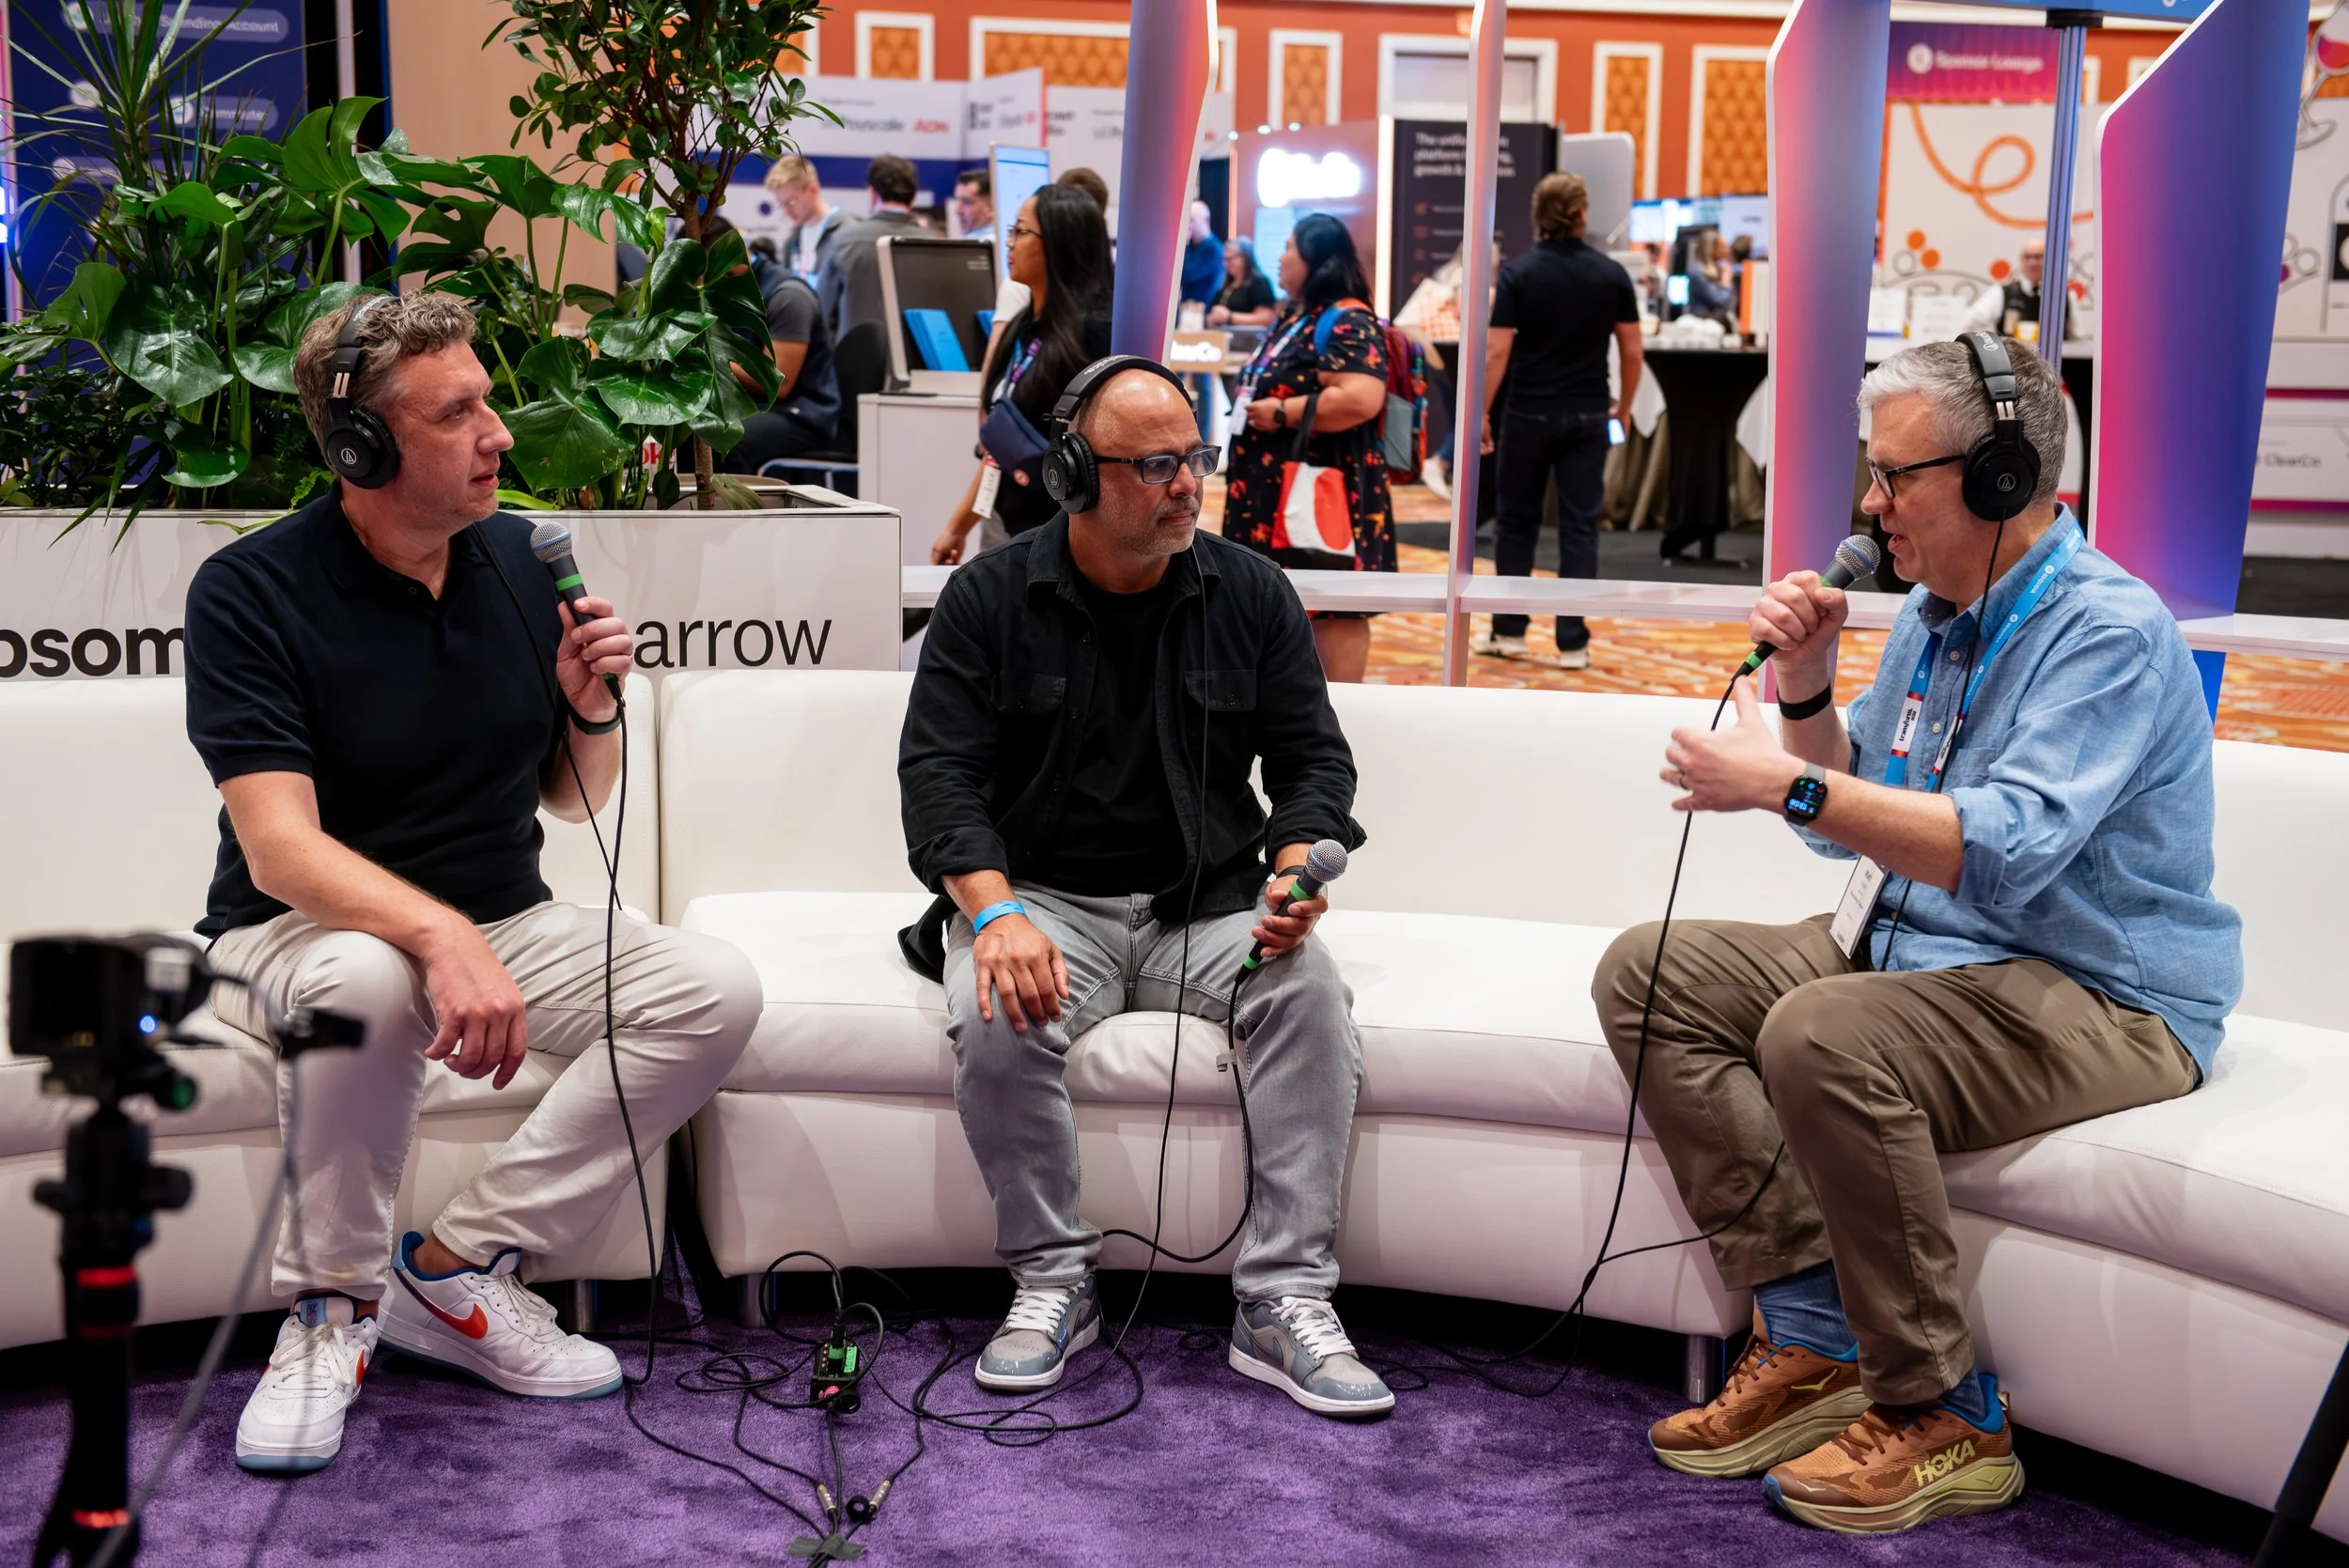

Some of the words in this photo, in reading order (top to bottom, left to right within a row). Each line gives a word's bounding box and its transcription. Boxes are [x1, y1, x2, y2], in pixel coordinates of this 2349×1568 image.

[2030, 572, 2048, 594] SEQUOIA
[633, 619, 832, 669] arrow
[1913, 1438, 1976, 1486] HOKA
